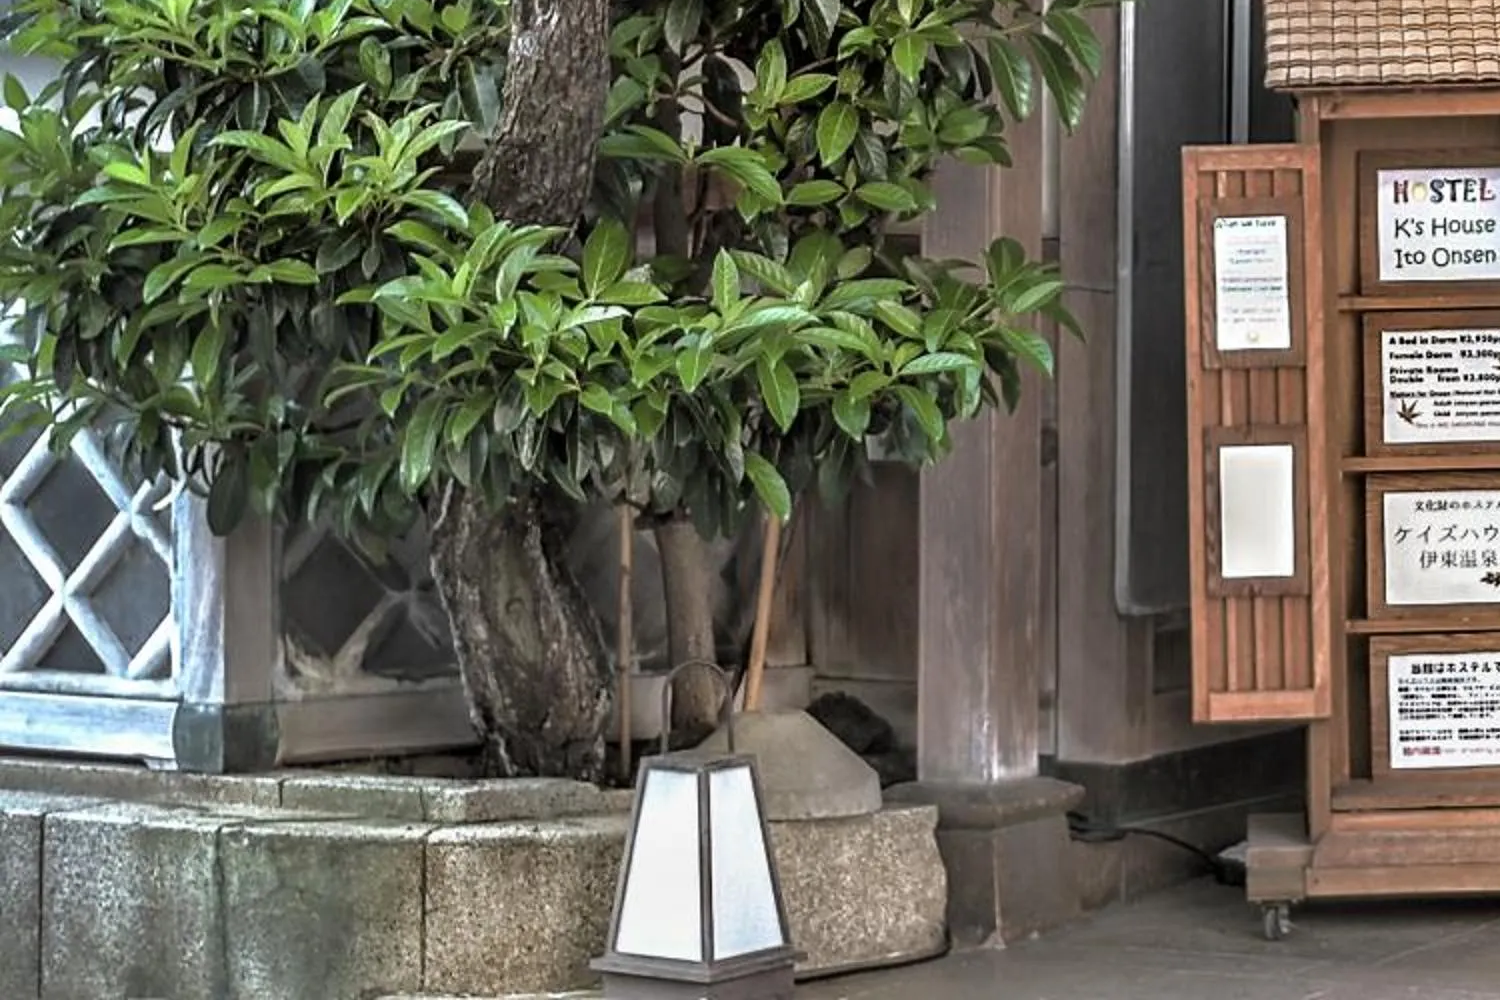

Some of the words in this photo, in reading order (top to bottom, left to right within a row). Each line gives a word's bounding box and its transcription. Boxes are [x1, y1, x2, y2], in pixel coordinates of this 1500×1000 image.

[1393, 178, 1497, 204] HOSTEL
[1394, 217, 1425, 239] K's
[1431, 217, 1497, 236] House
[1394, 248, 1426, 269] Ito
[1431, 247, 1498, 268] Onsen
[1389, 336, 1397, 345] A
[1420, 549, 1498, 569] 伊東温泉
